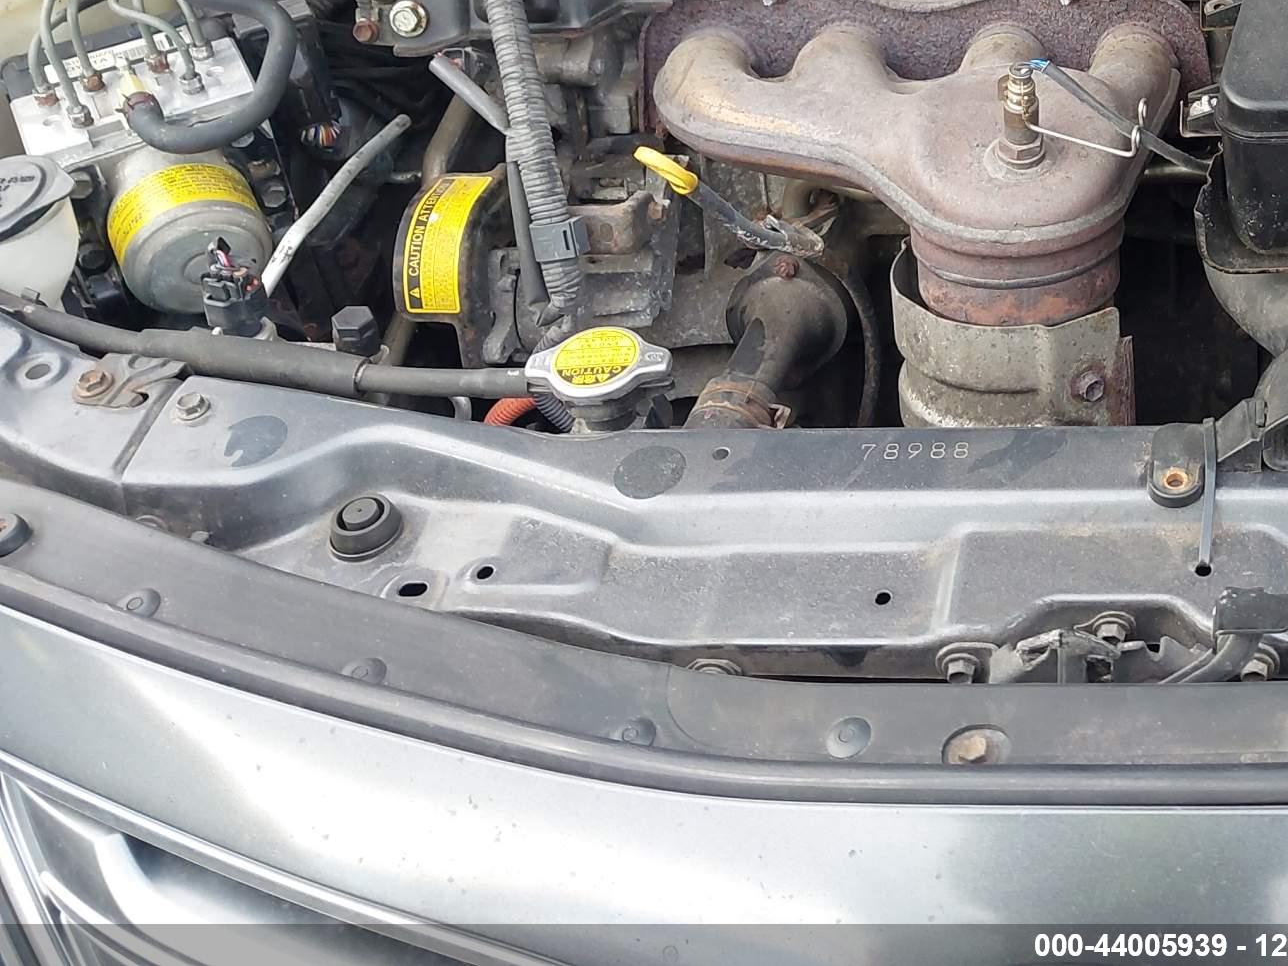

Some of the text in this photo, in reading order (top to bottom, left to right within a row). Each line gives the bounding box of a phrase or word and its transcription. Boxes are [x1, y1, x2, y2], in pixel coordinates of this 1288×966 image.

[408, 227, 426, 277] CAUTION
[418, 183, 447, 223] ATTENTION
[562, 365, 622, 376] CAUTION
[861, 442, 969, 461] 78988
